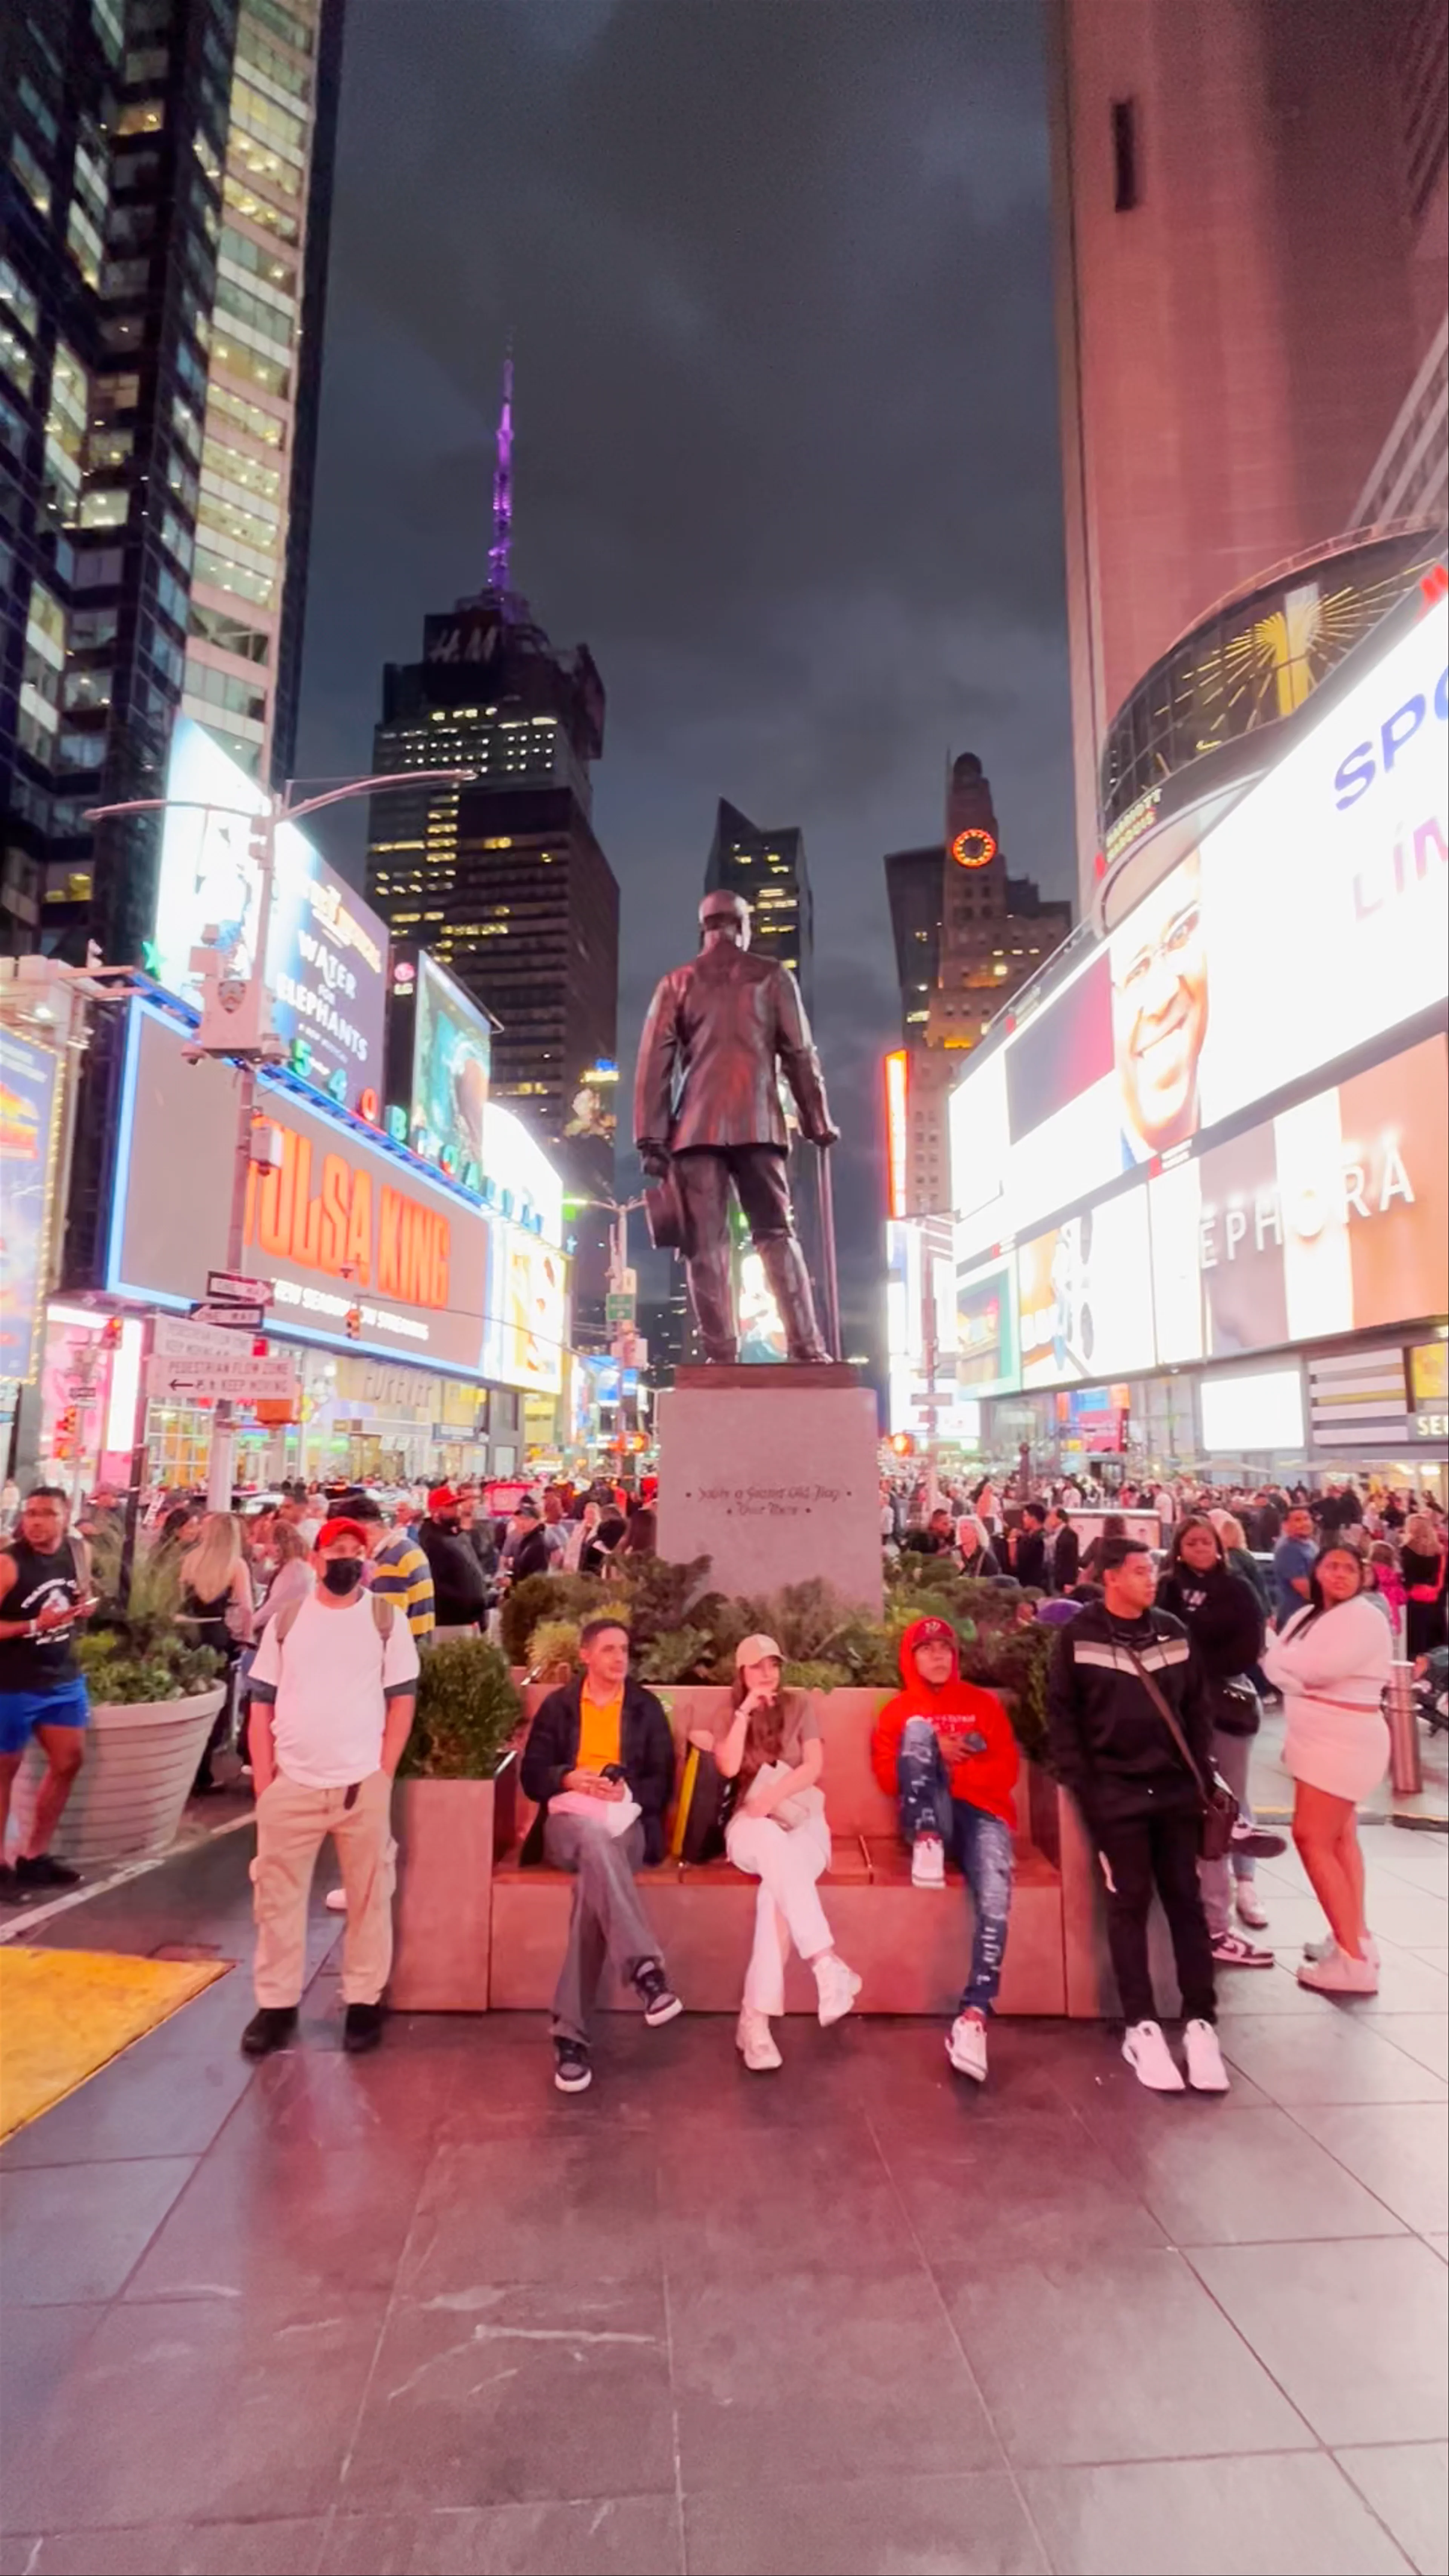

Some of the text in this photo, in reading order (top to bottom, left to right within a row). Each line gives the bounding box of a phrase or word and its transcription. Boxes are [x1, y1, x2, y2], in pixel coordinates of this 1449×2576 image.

[1334, 665, 1448, 811] SP
[276, 972, 368, 1061] ELEPHANTS
[298, 929, 357, 999] WATER
[243, 1115, 450, 1312] TULSA KING
[1200, 1132, 1416, 1269] EPHORA
